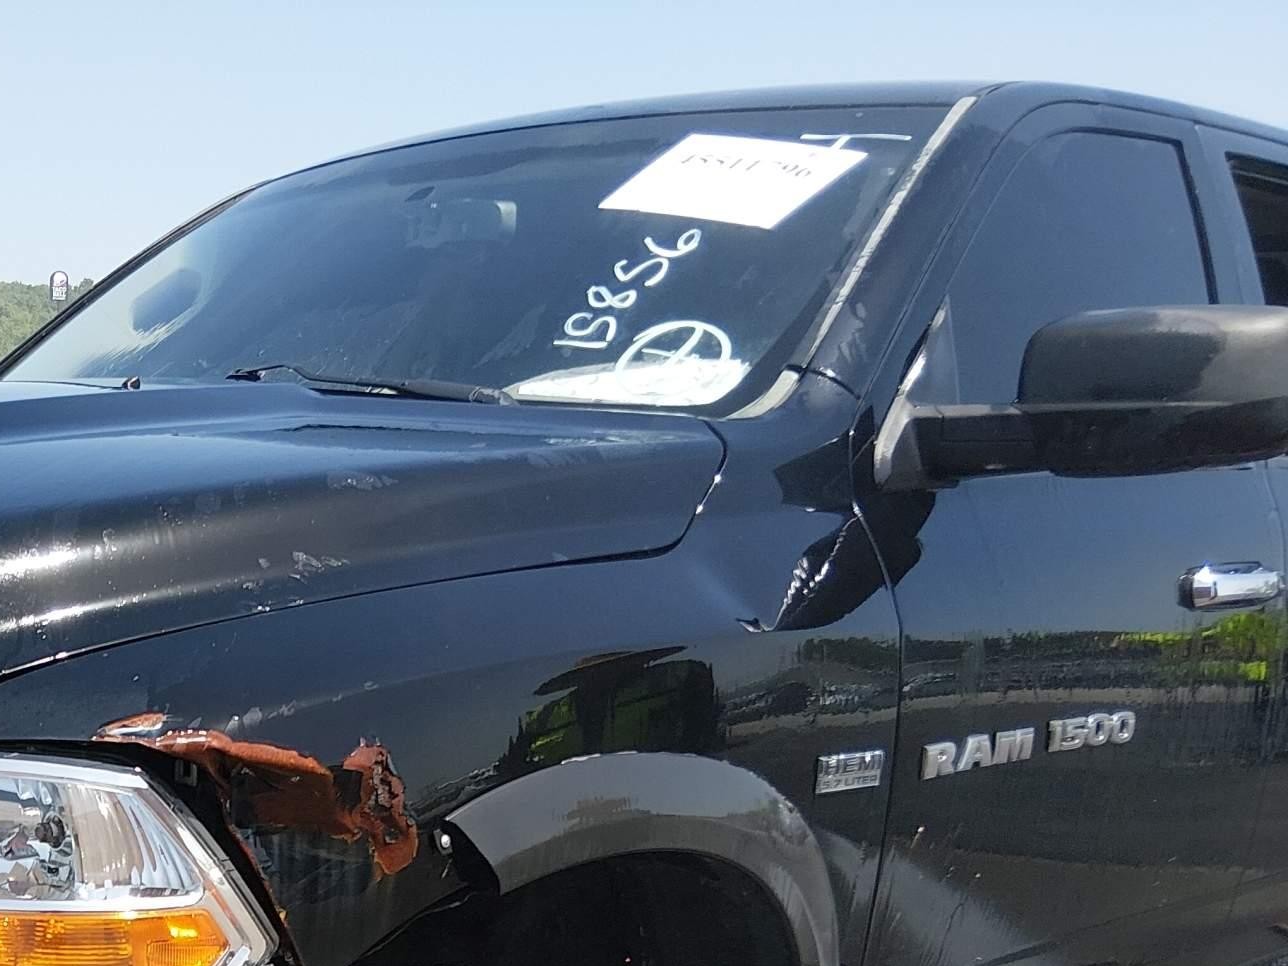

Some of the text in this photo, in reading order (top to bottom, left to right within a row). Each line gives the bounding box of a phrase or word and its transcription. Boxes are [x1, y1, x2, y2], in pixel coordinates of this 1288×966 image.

[820, 753, 881, 776] HEMI
[920, 711, 1136, 781] RAM 1500
